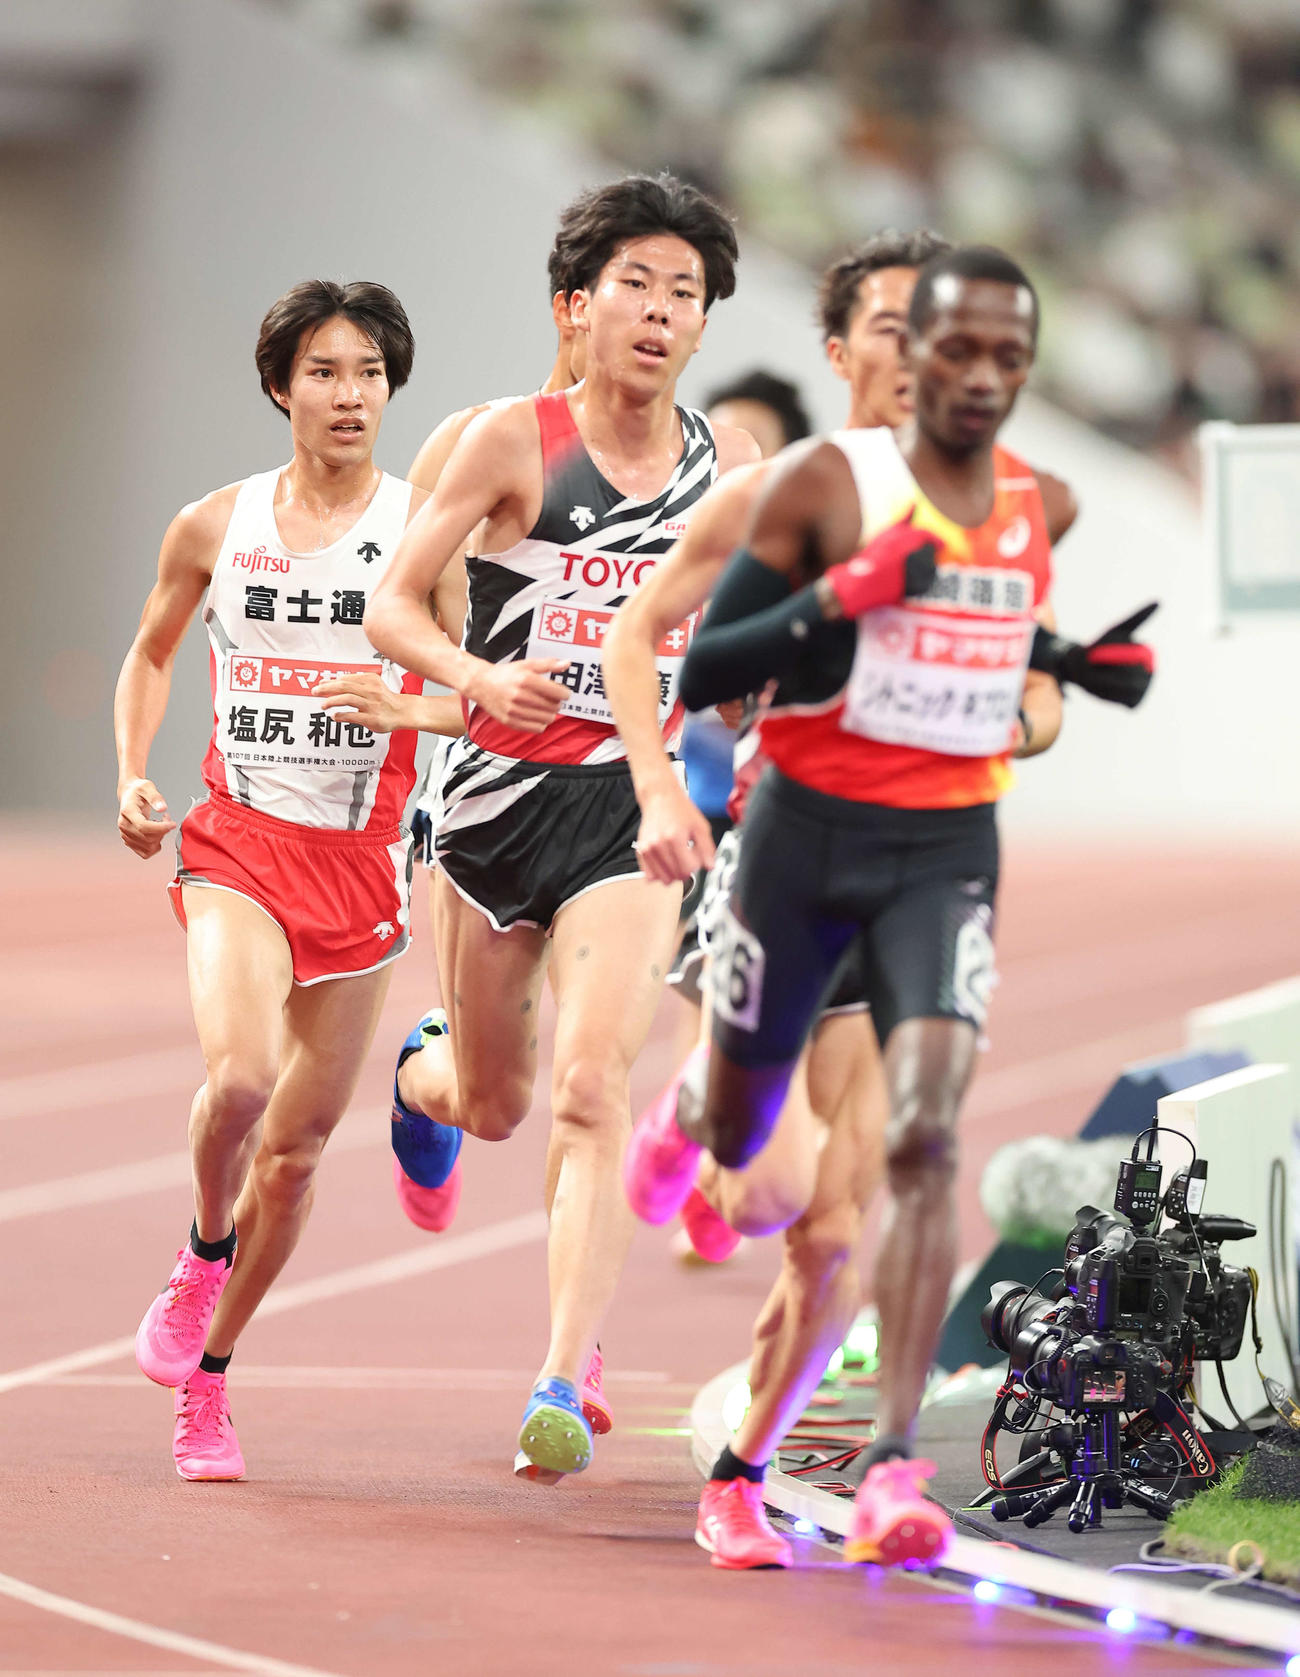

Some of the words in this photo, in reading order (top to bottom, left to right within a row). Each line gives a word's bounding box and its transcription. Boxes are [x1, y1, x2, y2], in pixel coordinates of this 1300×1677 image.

[665, 521, 687, 531] GA
[232, 546, 291, 575] FUJITSU
[244, 585, 366, 626] 富士通
[268, 665, 367, 690] ヤマ
[227, 705, 296, 746] 塩尻
[307, 711, 377, 749] 和也
[984, 1448, 998, 1482] EOS
[1181, 1429, 1209, 1475] Canon
